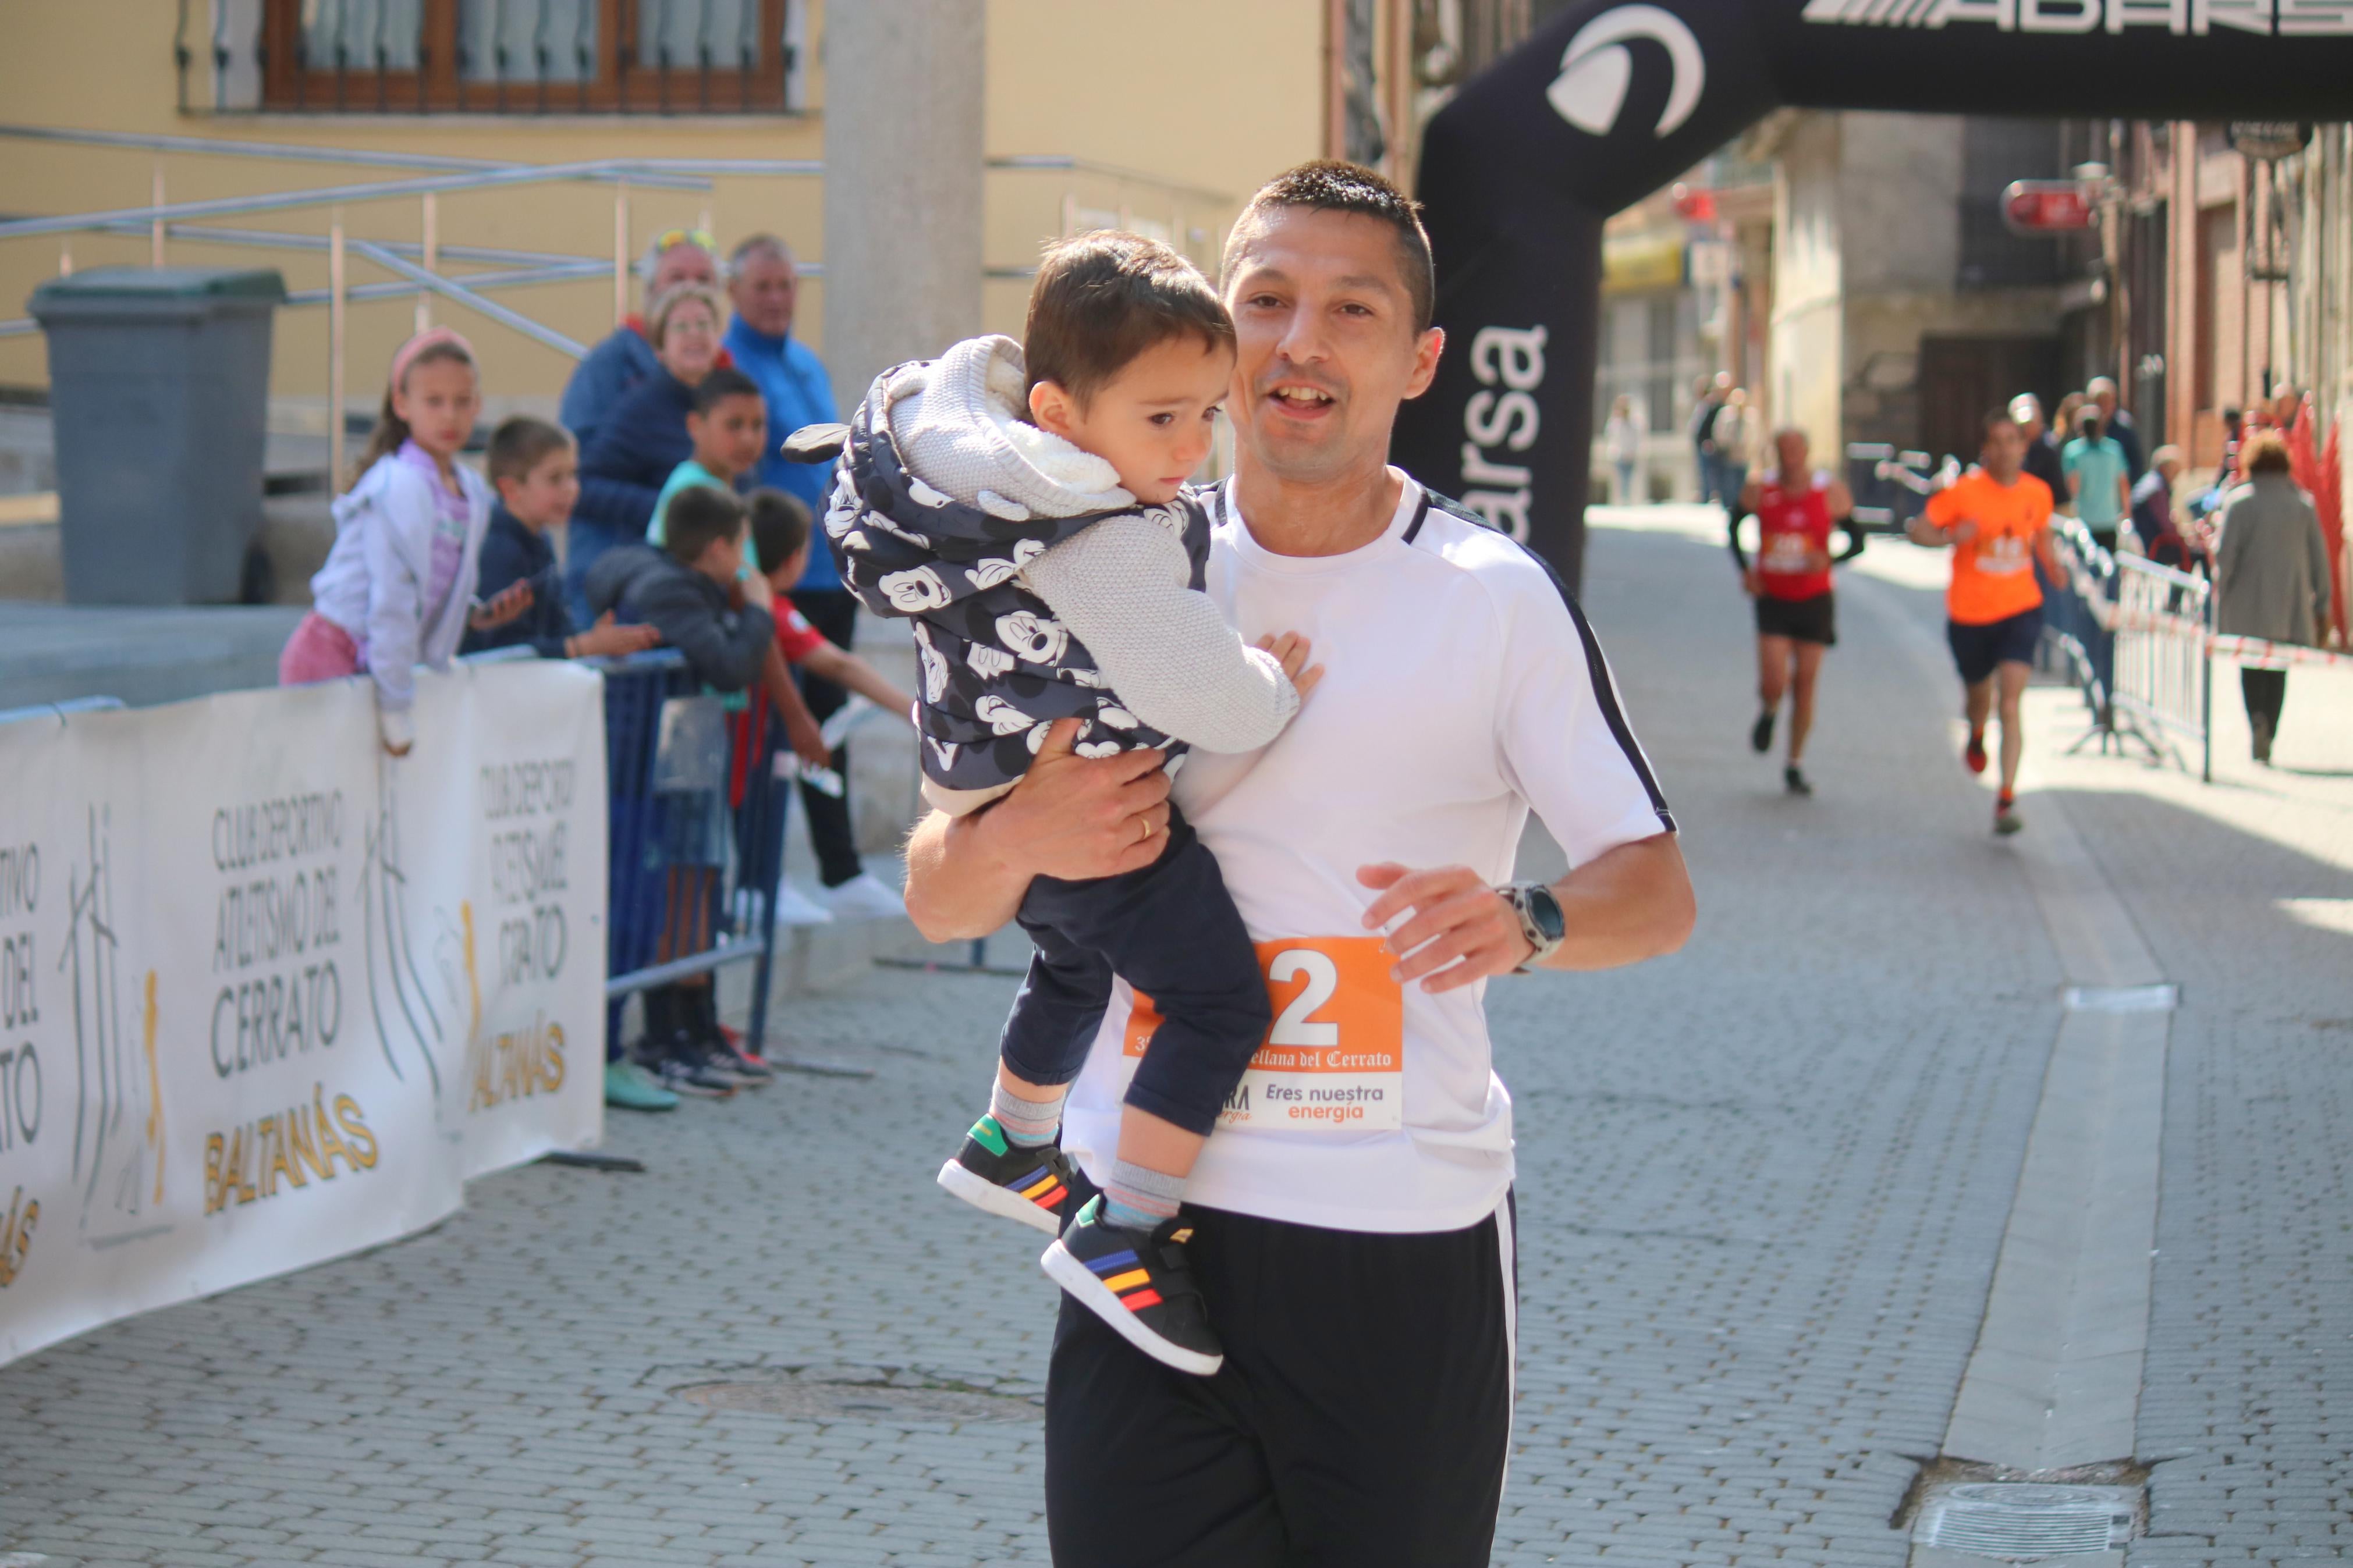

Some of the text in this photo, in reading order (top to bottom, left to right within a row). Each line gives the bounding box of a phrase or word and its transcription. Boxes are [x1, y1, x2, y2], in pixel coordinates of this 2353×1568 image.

[1460, 323, 1549, 546] arsa
[3, 933, 38, 1029] DEL
[211, 958, 340, 1078] CERRATO
[1268, 949, 1338, 1046] 2
[1251, 1050, 1295, 1066] ellana
[1300, 1051, 1321, 1067] del
[1326, 1051, 1392, 1067] Cerrato
[1266, 1084, 1303, 1101] Eres
[1309, 1086, 1383, 1101] nuestra
[205, 1081, 378, 1216] BALTANÁS
[1288, 1102, 1364, 1123] energía
